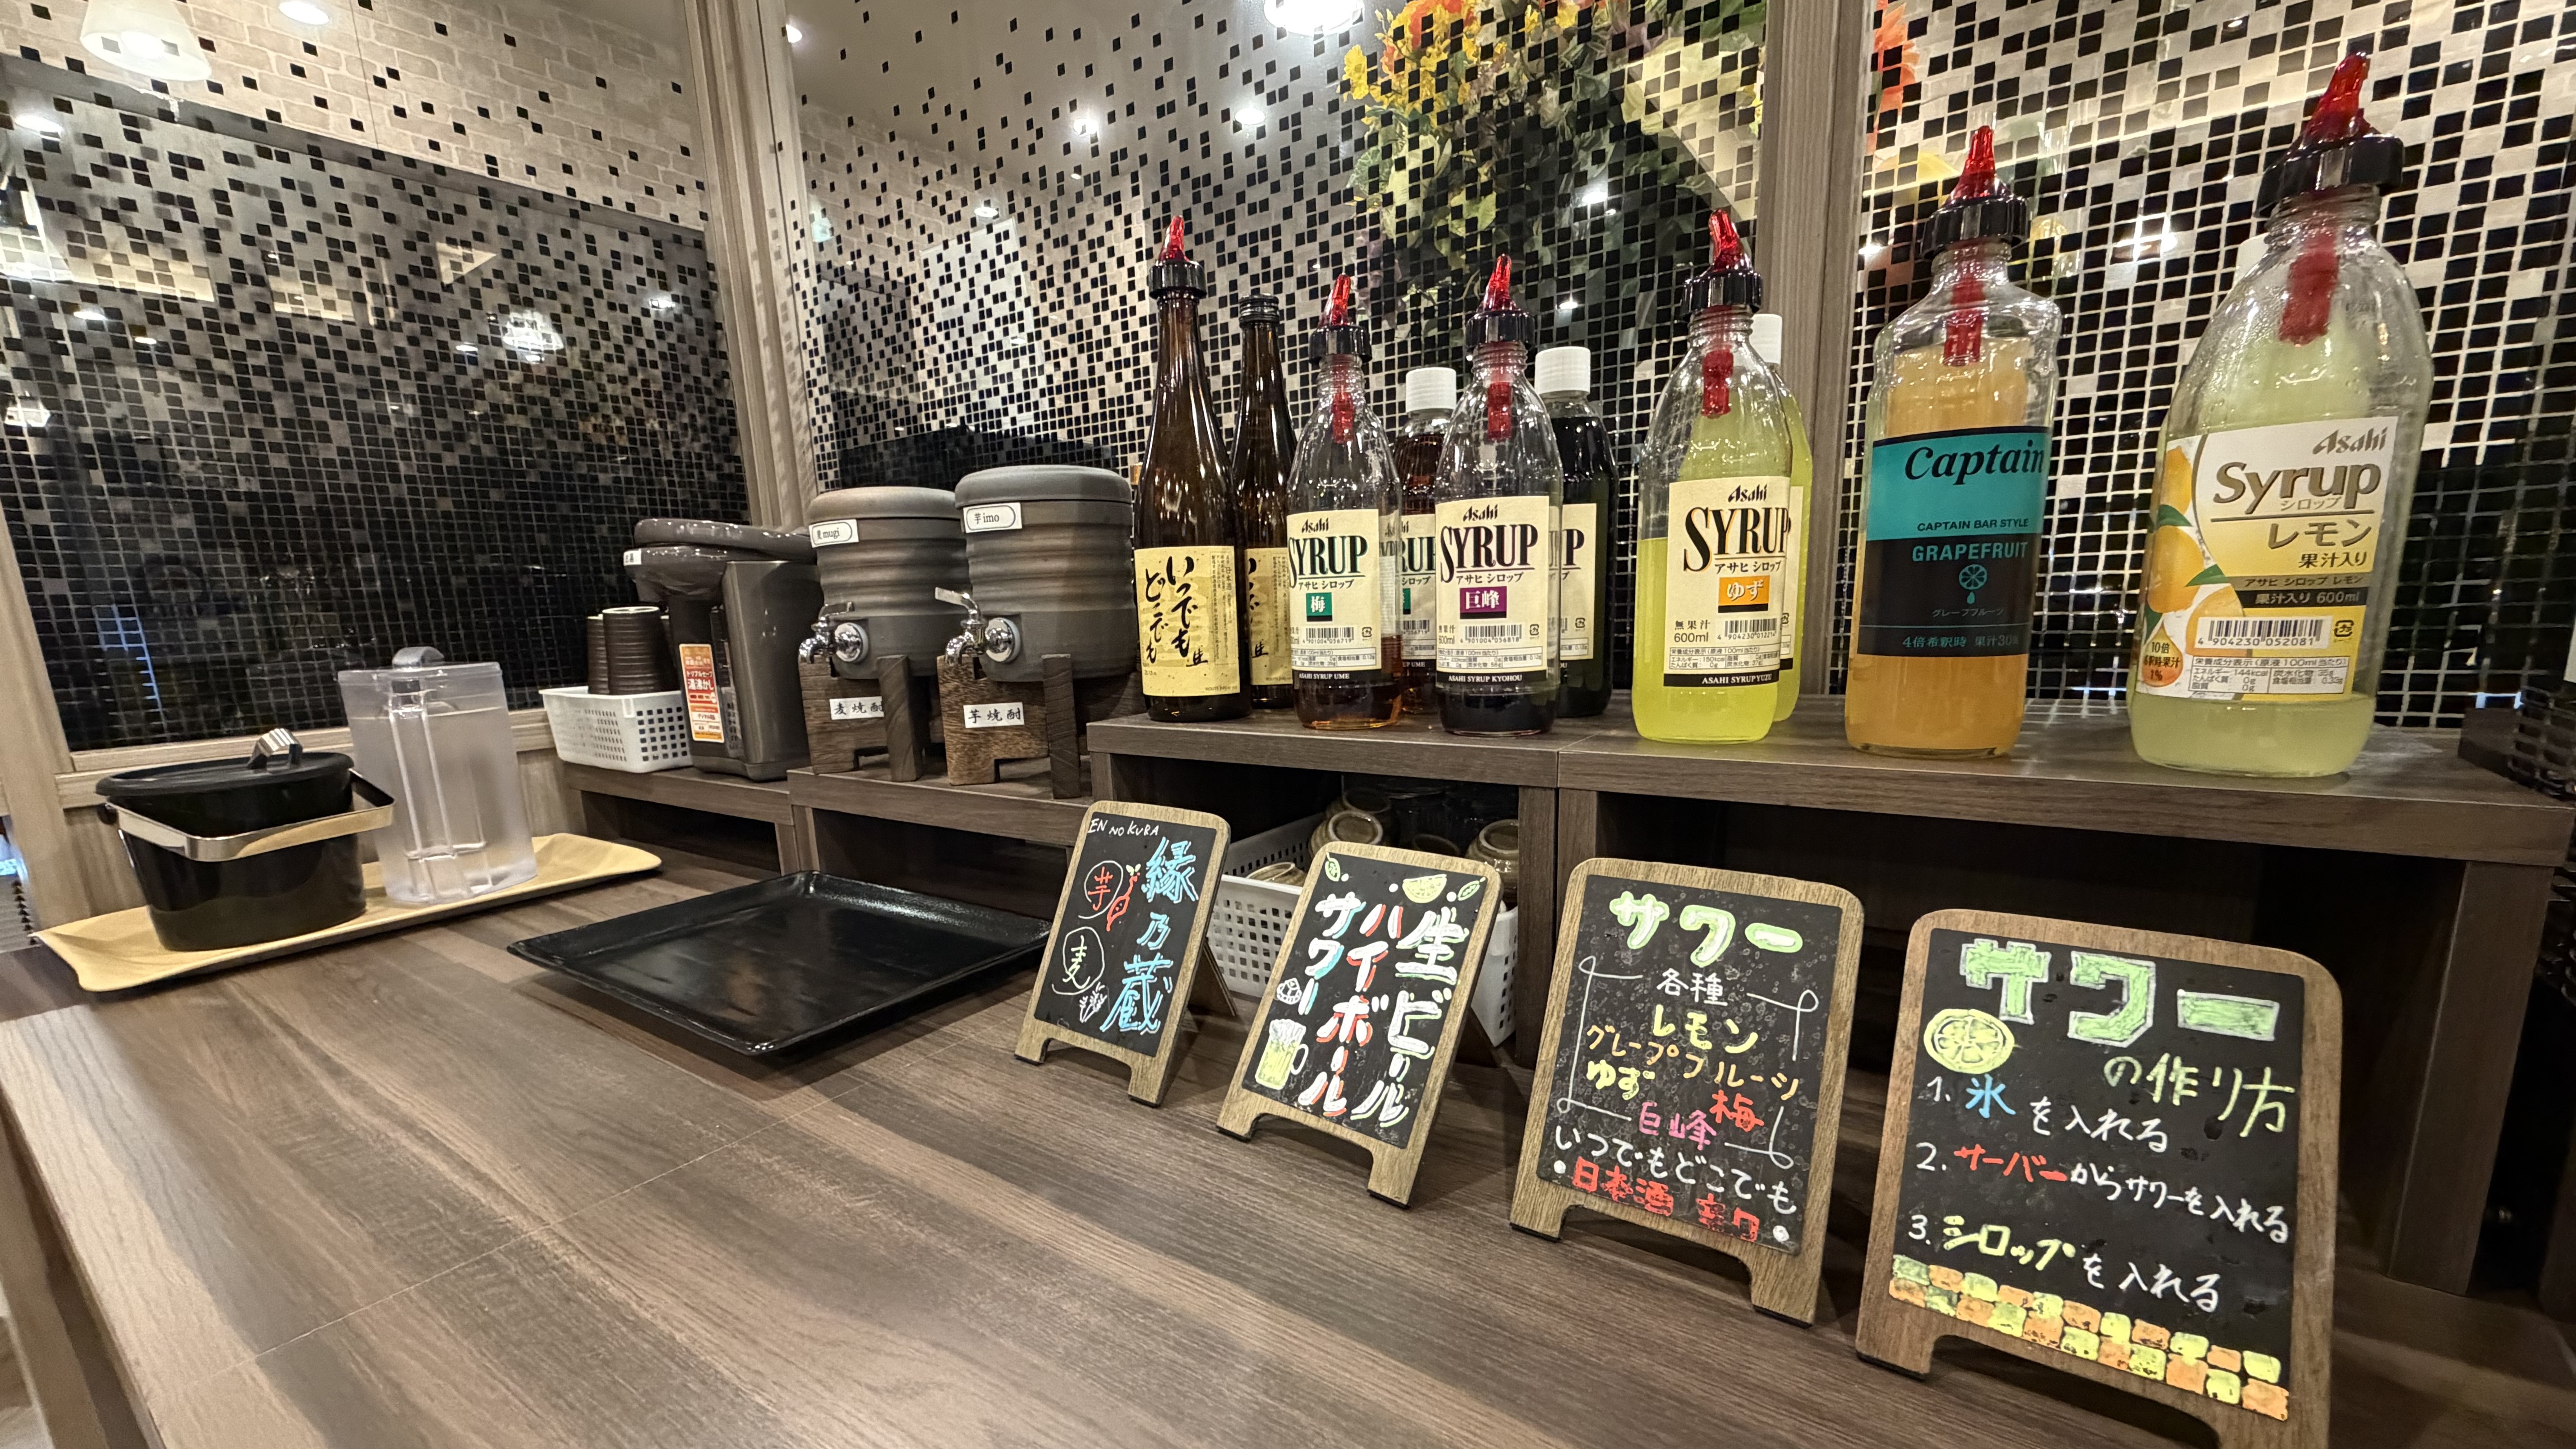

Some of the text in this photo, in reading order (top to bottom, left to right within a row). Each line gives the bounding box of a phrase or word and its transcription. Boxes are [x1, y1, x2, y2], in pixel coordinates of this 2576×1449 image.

[2312, 426, 2387, 455] Asahi
[1905, 439, 2044, 485] Captain
[1728, 484, 1767, 502] Asahi
[2213, 461, 2381, 514] Syrup
[1463, 504, 1498, 521] Asahi
[2280, 496, 2341, 511] シロップ
[1302, 517, 1329, 534] Asahi
[1918, 518, 2029, 531] CAPTAIN BAR STYLE
[2268, 519, 2371, 549] レモン
[1288, 535, 1368, 589] SYRUP
[1440, 524, 1538, 583] SYRUP
[1913, 542, 2028, 562] GRAPEFRUIT
[2298, 552, 2367, 569] 果汁入り
[1456, 572, 1524, 585] アサヒ シロップ
[1715, 560, 1782, 574] アサヒ シロップ
[2245, 576, 2364, 587] アサヒ シロップ レモン
[1298, 579, 1355, 590] アサヒ シロップ
[1727, 580, 1764, 601] ゆず
[2255, 591, 2360, 604] 果汁入り 600ml
[1166, 557, 1198, 658] いつでも
[1311, 596, 1326, 613] 梅
[1465, 590, 1500, 610] 巨峰
[1674, 620, 1710, 630] 無果汁
[1674, 632, 1708, 643] 600ml
[2152, 642, 2170, 653] 10倍
[2213, 638, 2259, 646] 904230
[2266, 637, 2314, 646] 052081
[833, 701, 883, 716] 麦焼酎
[968, 708, 1021, 723] 芋焼酎
[1088, 818, 1108, 833] EN
[1109, 826, 1124, 837] NO
[1088, 866, 1113, 911] 芋
[1099, 837, 1199, 1035] 縁乃蔵
[1610, 891, 1803, 967] サワー
[1062, 935, 1091, 989] 麦
[1298, 892, 1366, 1015] サワー
[1656, 968, 1728, 1006] 各種
[1959, 938, 2280, 1048] サワー
[1298, 904, 1403, 1117] ハイボール
[1351, 906, 1469, 1127] 生ビール
[1653, 1004, 1758, 1053] レモン
[1587, 1024, 1799, 1100] グレープフルーツ
[1586, 1059, 1655, 1100] ゆず
[2105, 1052, 2295, 1137] の作り方
[1709, 1090, 1764, 1132] 梅
[1556, 1126, 1797, 1214] いつでもどこでも
[1573, 1156, 1759, 1242] 日本酒 辛口
